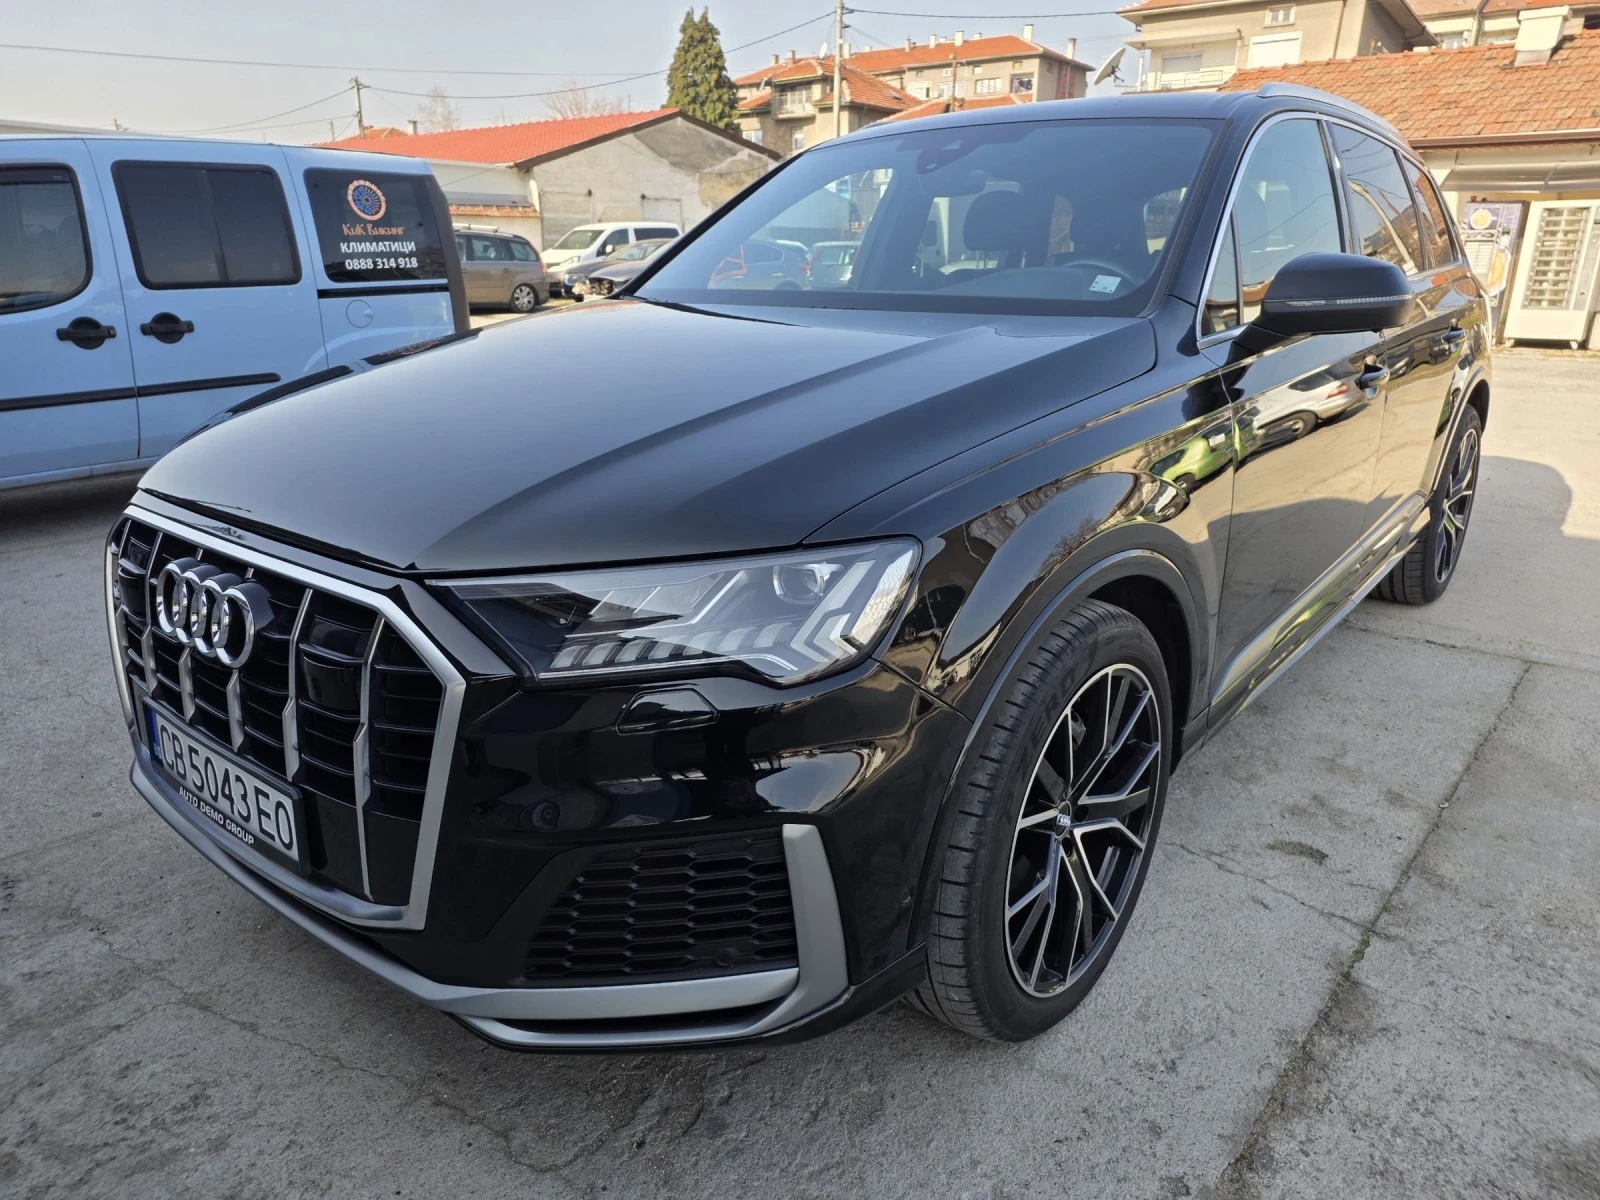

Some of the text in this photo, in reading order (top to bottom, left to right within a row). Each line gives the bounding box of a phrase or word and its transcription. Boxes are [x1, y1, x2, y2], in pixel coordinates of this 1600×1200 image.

[367, 223, 405, 236] Викинг
[340, 241, 416, 254] КЛИМАТИЦИ
[345, 257, 418, 270] 0888 314 918
[179, 786, 255, 845] AUTO DEMO GROUP
